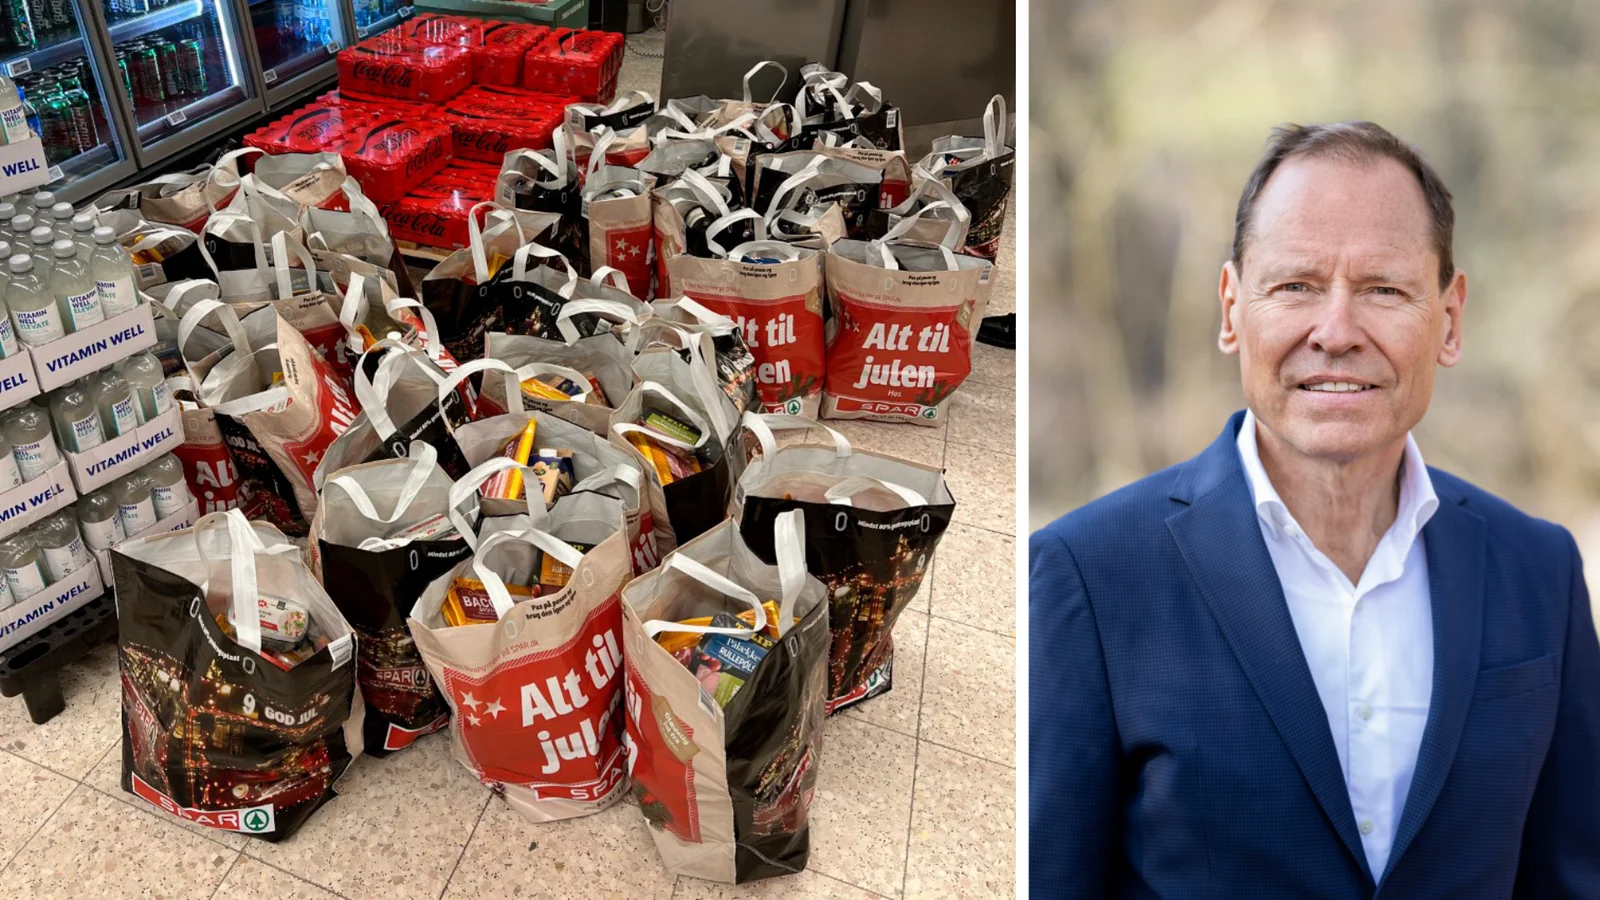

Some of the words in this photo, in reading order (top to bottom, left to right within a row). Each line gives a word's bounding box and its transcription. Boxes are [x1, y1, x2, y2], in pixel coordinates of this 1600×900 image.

[2, 158, 40, 177] WELL
[72, 300, 90, 309] WELL
[765, 313, 796, 347] til
[861, 322, 912, 351] Alt
[917, 322, 950, 353] til
[46, 339, 107, 372] VITAMIN
[110, 324, 145, 346] WELL
[853, 355, 936, 389] julen
[887, 389, 902, 397] Hos
[861, 403, 918, 415] SPAR
[86, 443, 140, 477] VITAMIN
[141, 427, 174, 450] WELL
[29, 483, 64, 507] WELL
[0, 601, 54, 638] VITAMIN
[56, 581, 90, 605] WELL
[526, 612, 541, 620] brug
[541, 609, 552, 617] den
[543, 600, 552, 610] på
[501, 648, 511, 657] på
[376, 670, 411, 683] SPAR
[520, 668, 589, 727] Alt
[585, 628, 623, 690] til
[243, 694, 256, 714] 9
[264, 706, 295, 725] GOD
[298, 706, 319, 725] JUL
